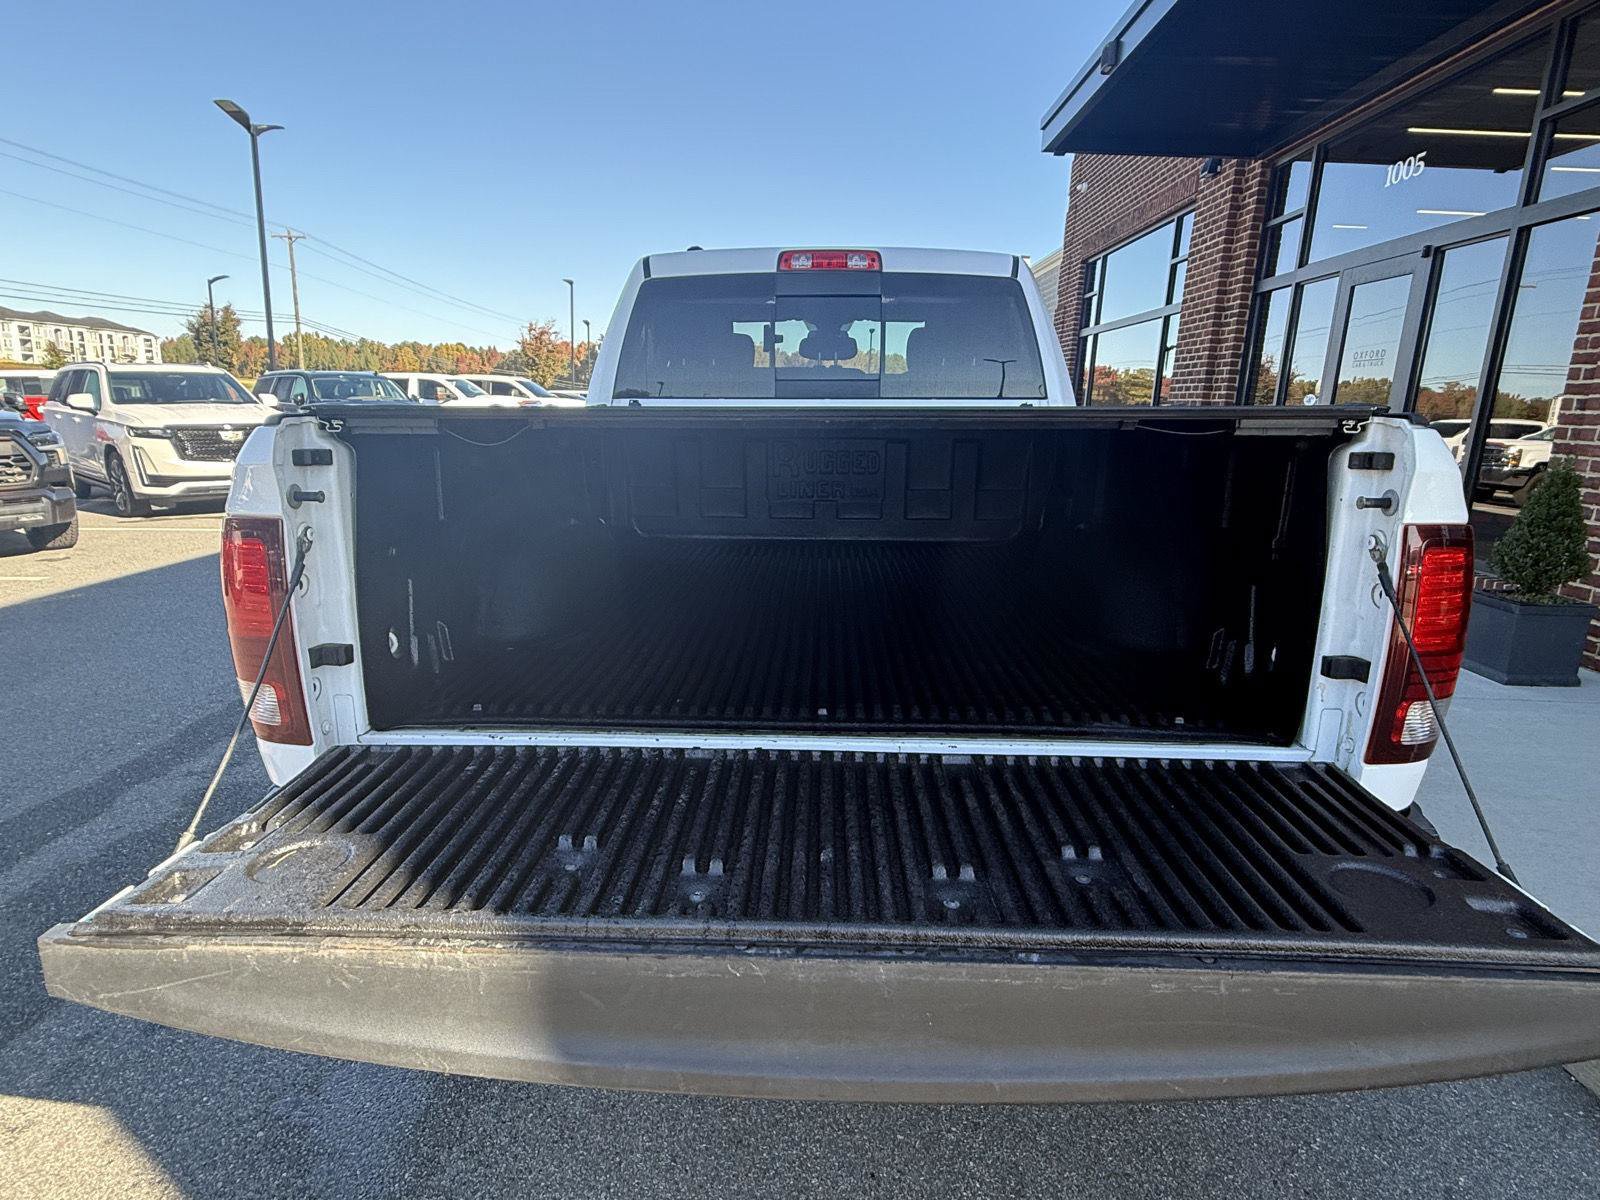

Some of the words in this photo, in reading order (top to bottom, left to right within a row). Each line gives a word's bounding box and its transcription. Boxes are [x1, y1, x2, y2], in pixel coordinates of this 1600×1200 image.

[1384, 150, 1427, 188] 1005
[1353, 349, 1386, 359] OXFORD
[772, 440, 880, 478] RUGGED
[776, 480, 845, 499] LINER
